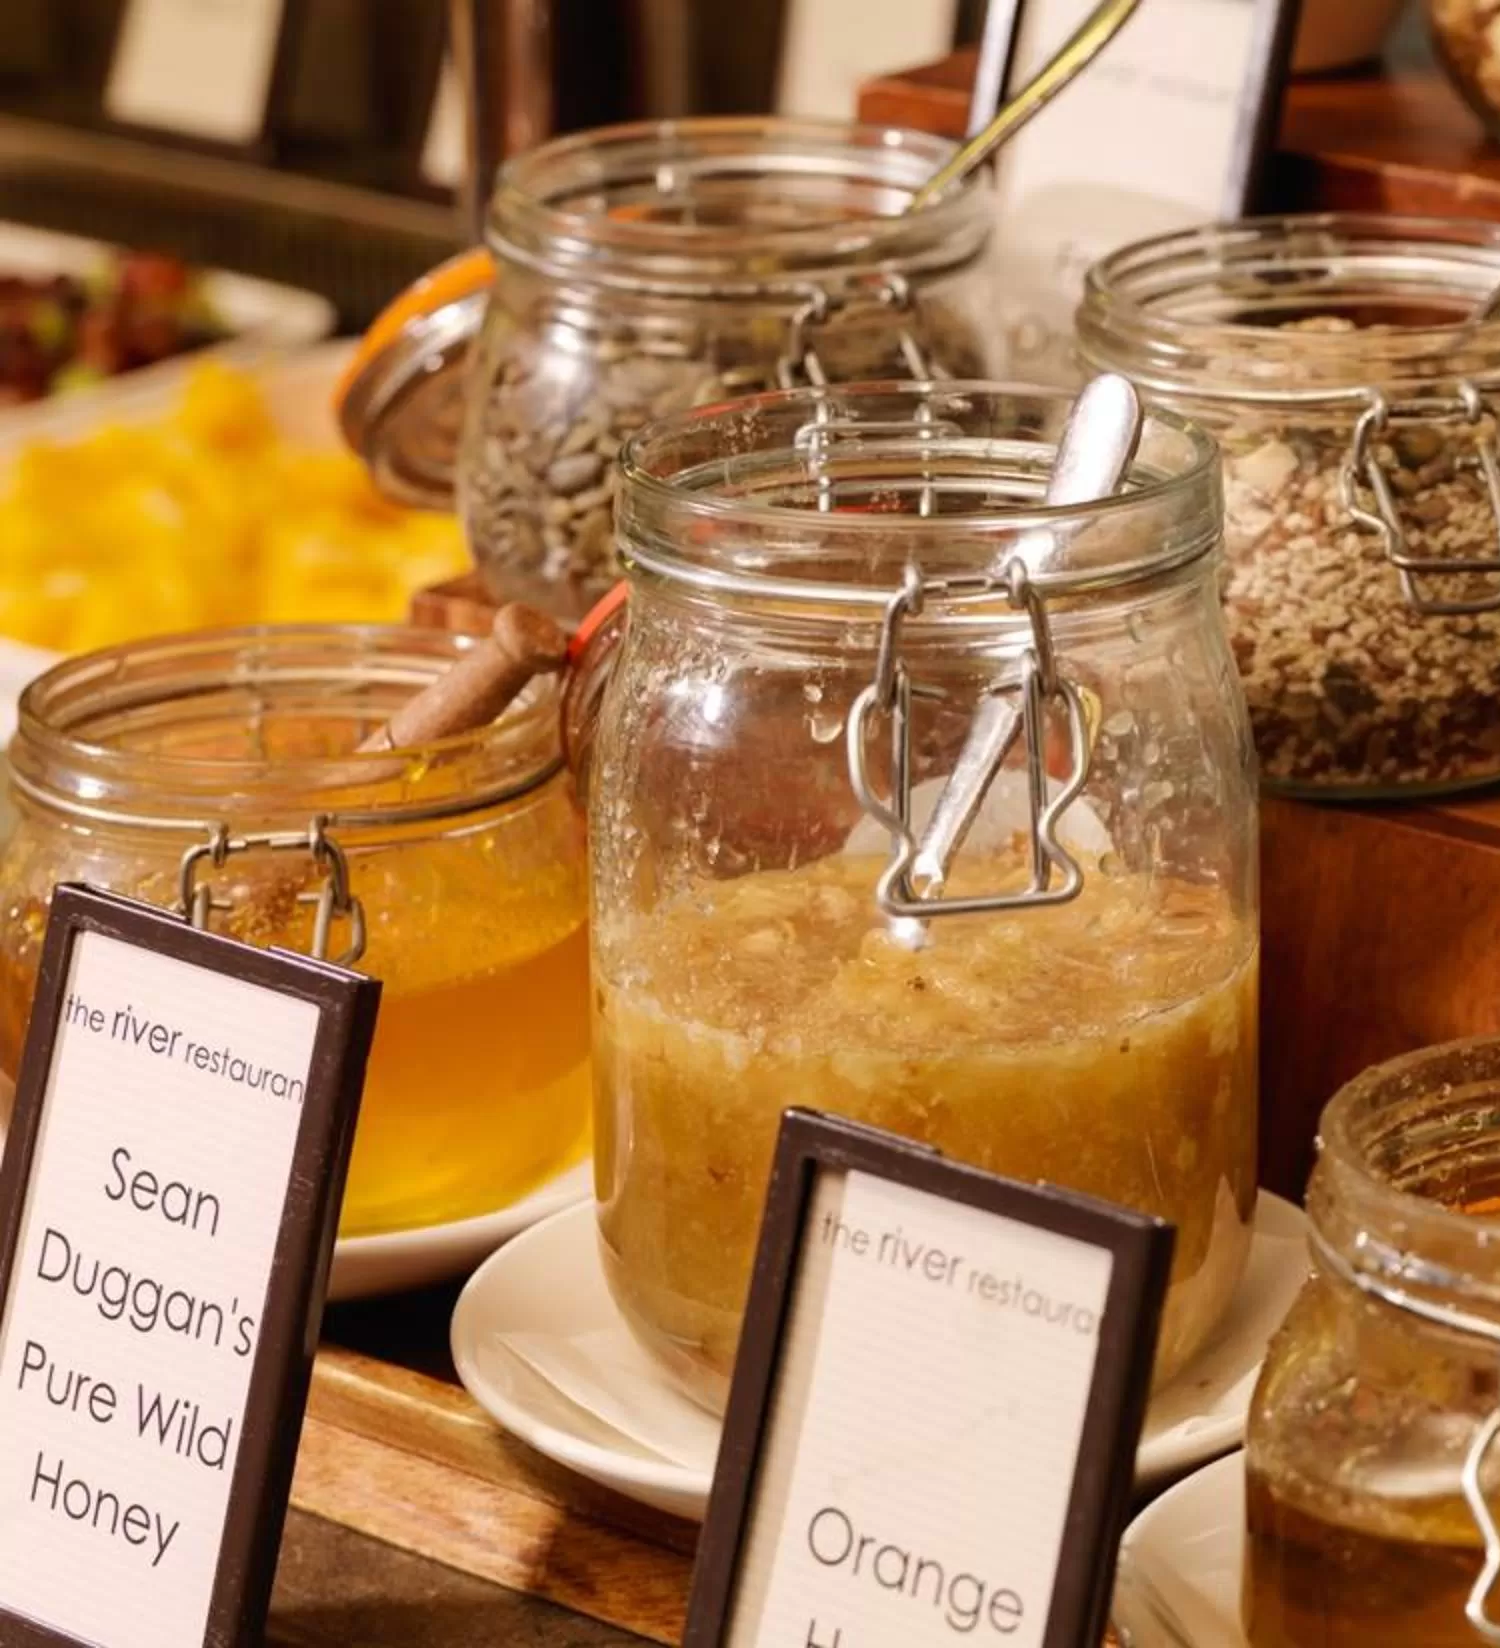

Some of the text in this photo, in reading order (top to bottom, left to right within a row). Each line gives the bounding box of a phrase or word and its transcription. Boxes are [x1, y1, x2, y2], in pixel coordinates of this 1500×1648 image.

[65, 993, 305, 1104] the river restauran
[104, 1146, 221, 1238] Sean
[37, 1228, 256, 1357] Duggan's
[821, 1211, 1094, 1335] the river restaura
[18, 1341, 233, 1471] Pure Wild
[30, 1452, 180, 1567] Honey
[808, 1507, 1024, 1634] Orange
